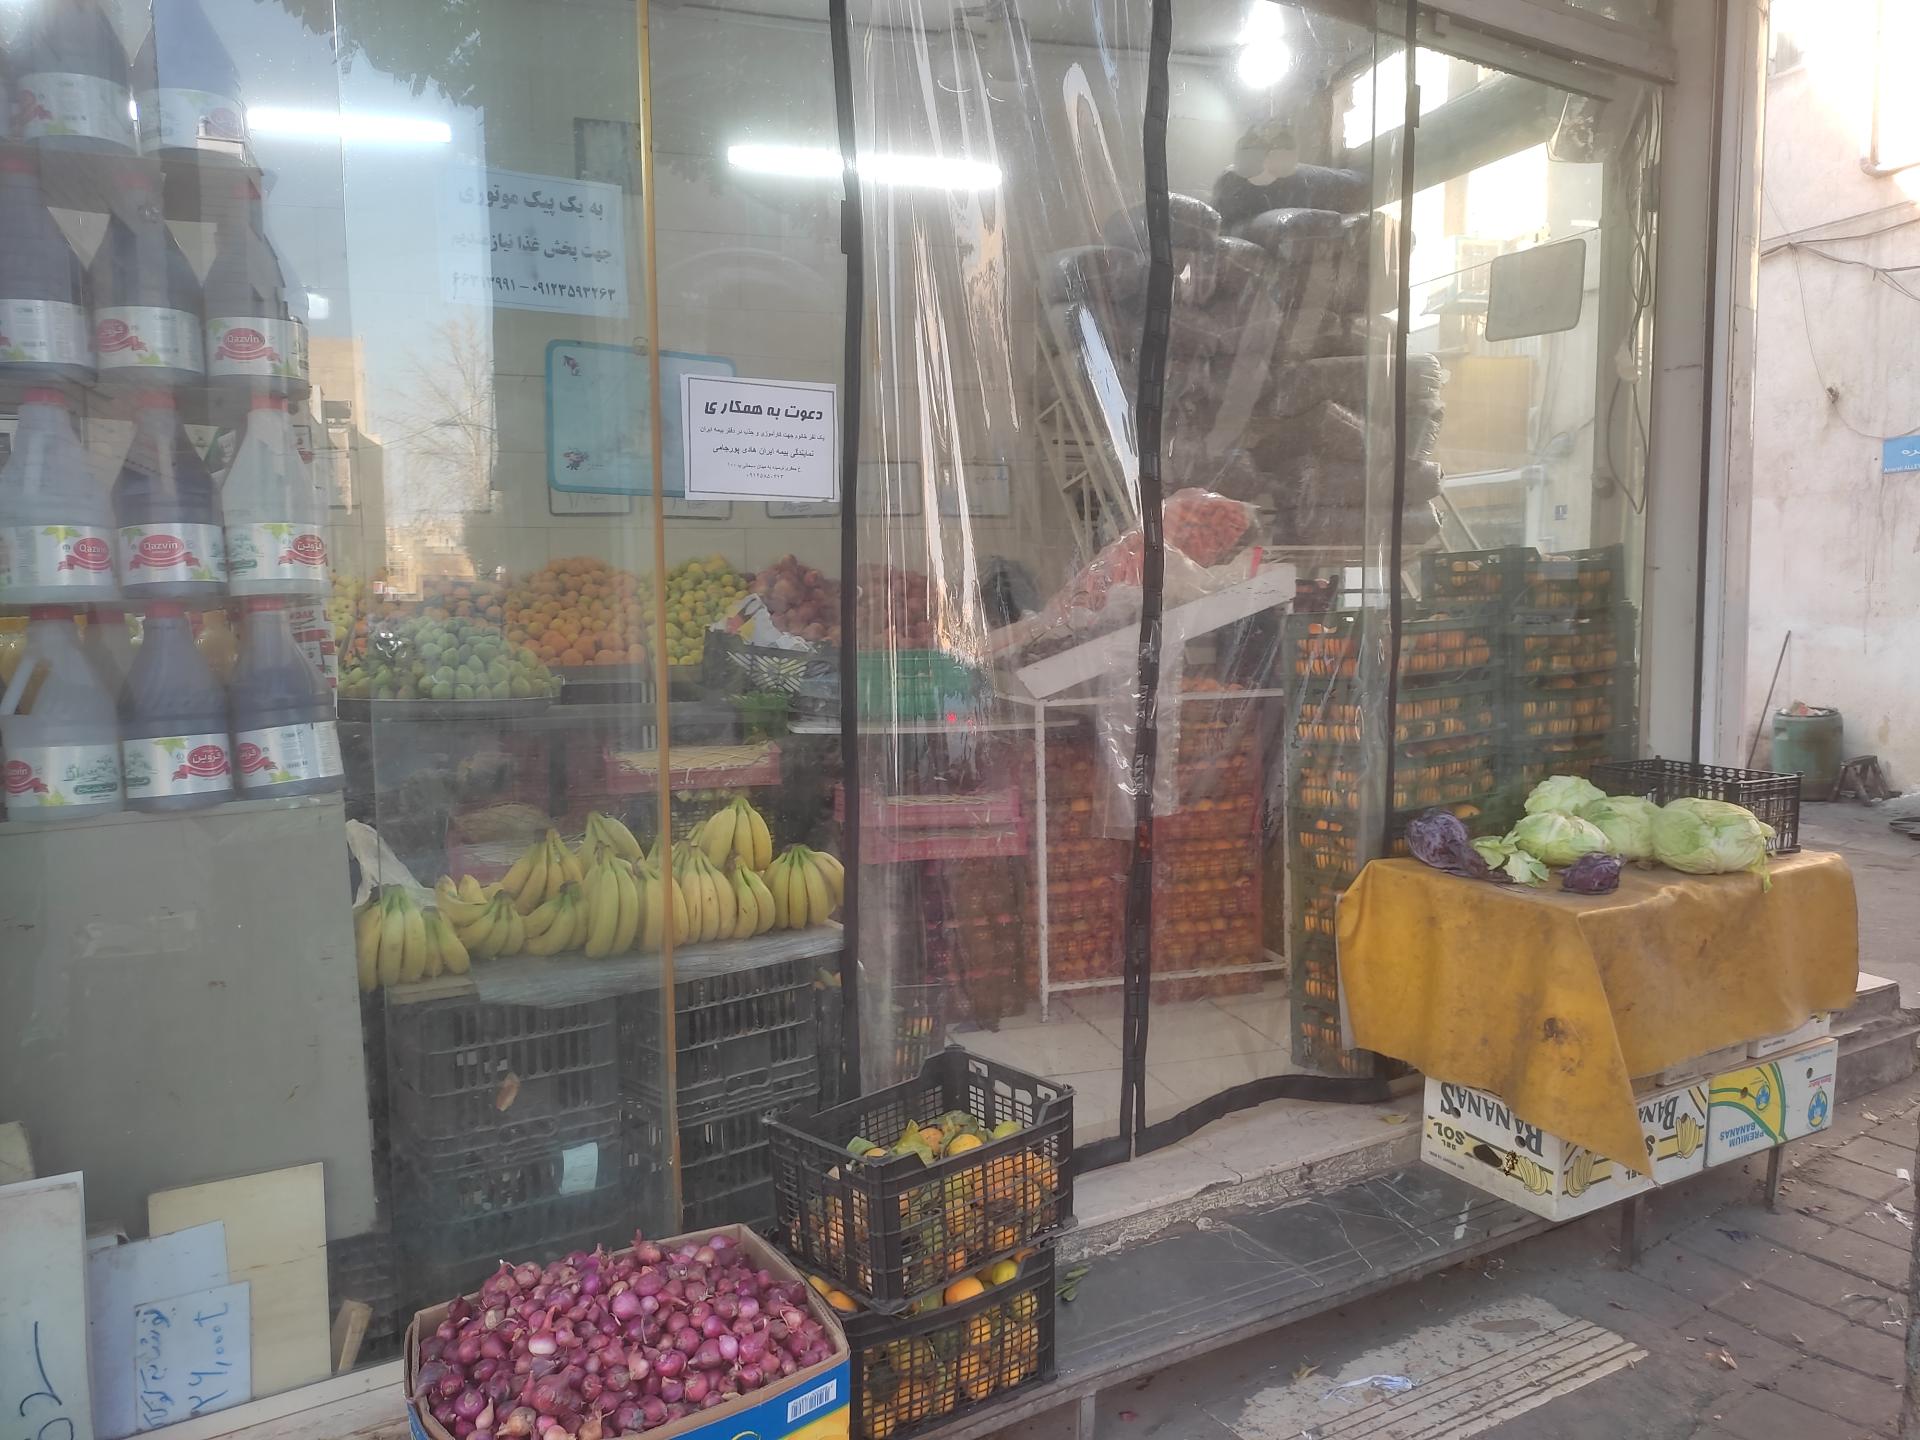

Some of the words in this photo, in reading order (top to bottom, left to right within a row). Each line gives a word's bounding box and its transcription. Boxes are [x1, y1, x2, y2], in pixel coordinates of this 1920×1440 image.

[524, 191, 555, 216] پیک
[560, 195, 583, 217] یک
[590, 202, 603, 220] به
[518, 234, 540, 251] غذا
[544, 240, 577, 262] پخش
[581, 246, 612, 263] جهت
[704, 399, 763, 415] همکاری
[766, 405, 781, 420] به
[784, 405, 823, 421] دعوت
[742, 446, 757, 454] هادی
[759, 447, 774, 456] ایران
[776, 448, 788, 457] بیمه
[790, 448, 815, 459] نمایندگی
[143, 540, 178, 551] Qazvin
[192, 748, 222, 764] قزوین
[1433, 1122, 1465, 1145] SOL
[1720, 1121, 1756, 1141] BANANAS
[1728, 1131, 1765, 1148] PREMIUM
